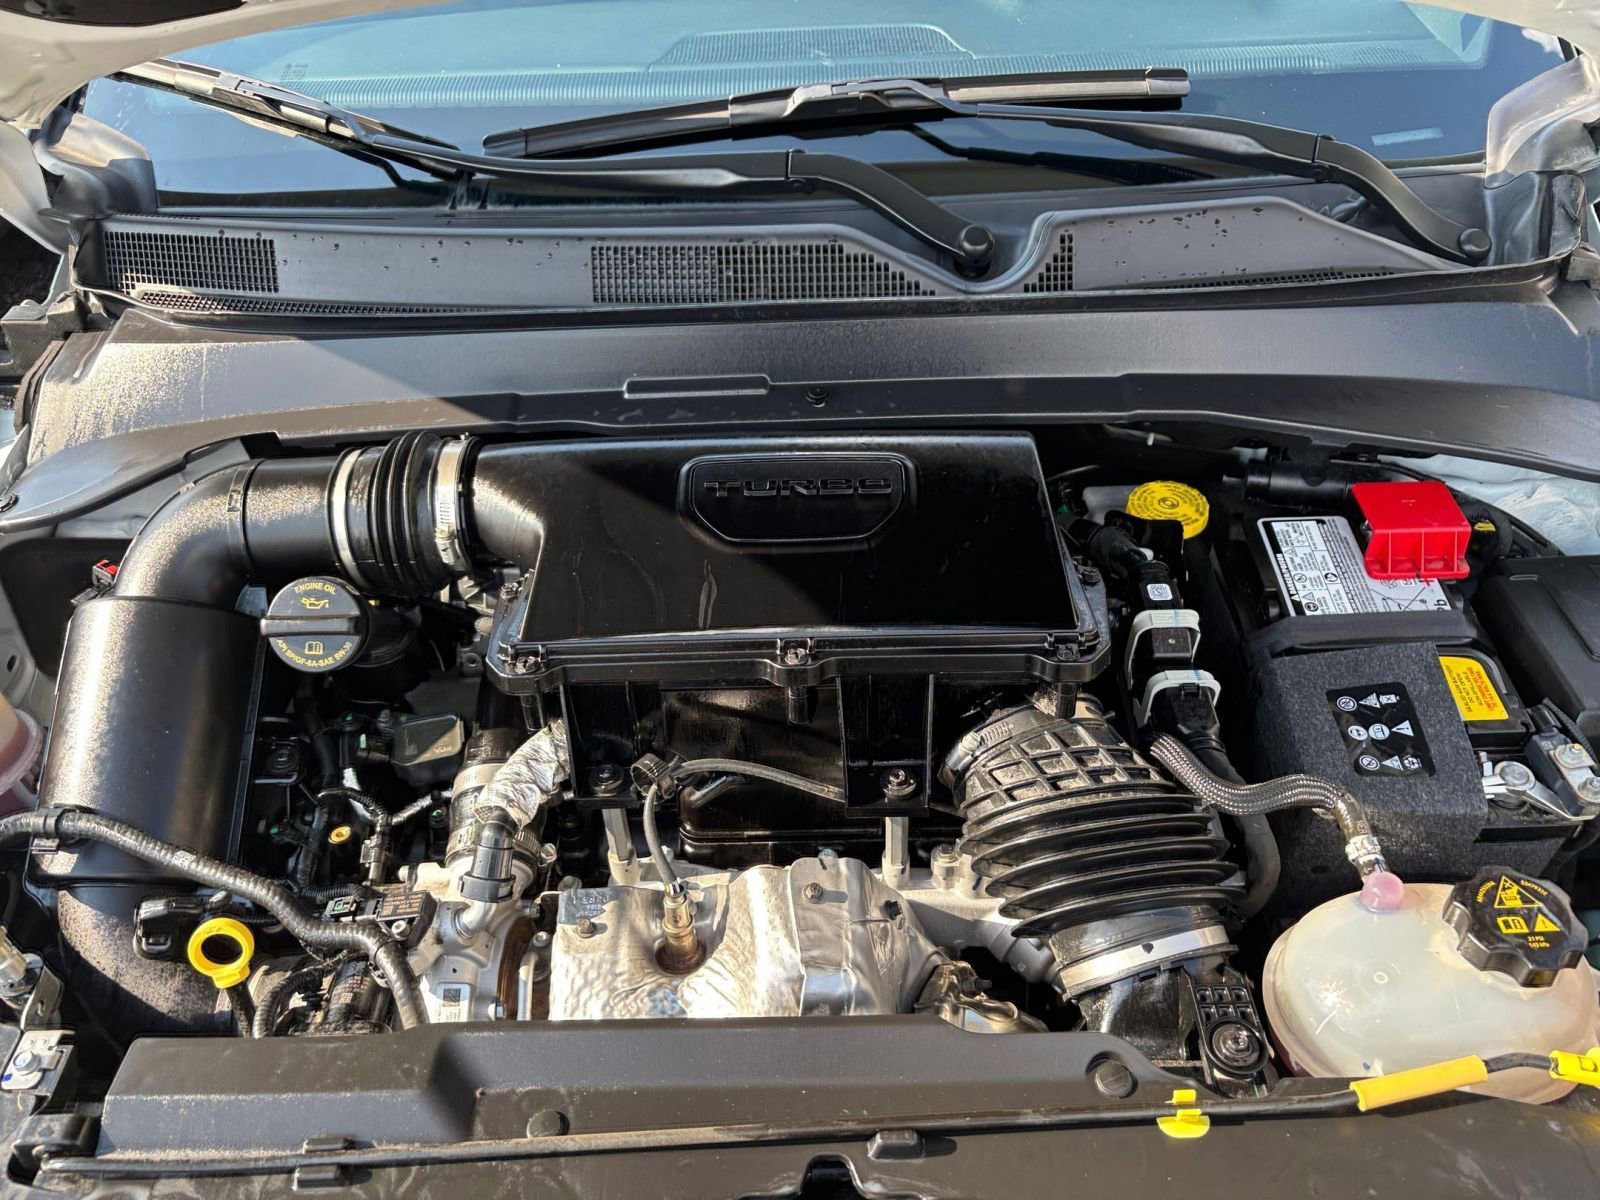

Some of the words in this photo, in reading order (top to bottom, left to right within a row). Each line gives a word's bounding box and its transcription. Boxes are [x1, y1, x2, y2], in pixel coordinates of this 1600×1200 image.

[703, 479, 893, 498] TURBO
[294, 582, 323, 594] ENGINE
[324, 584, 337, 596] OIL
[276, 639, 287, 652] API
